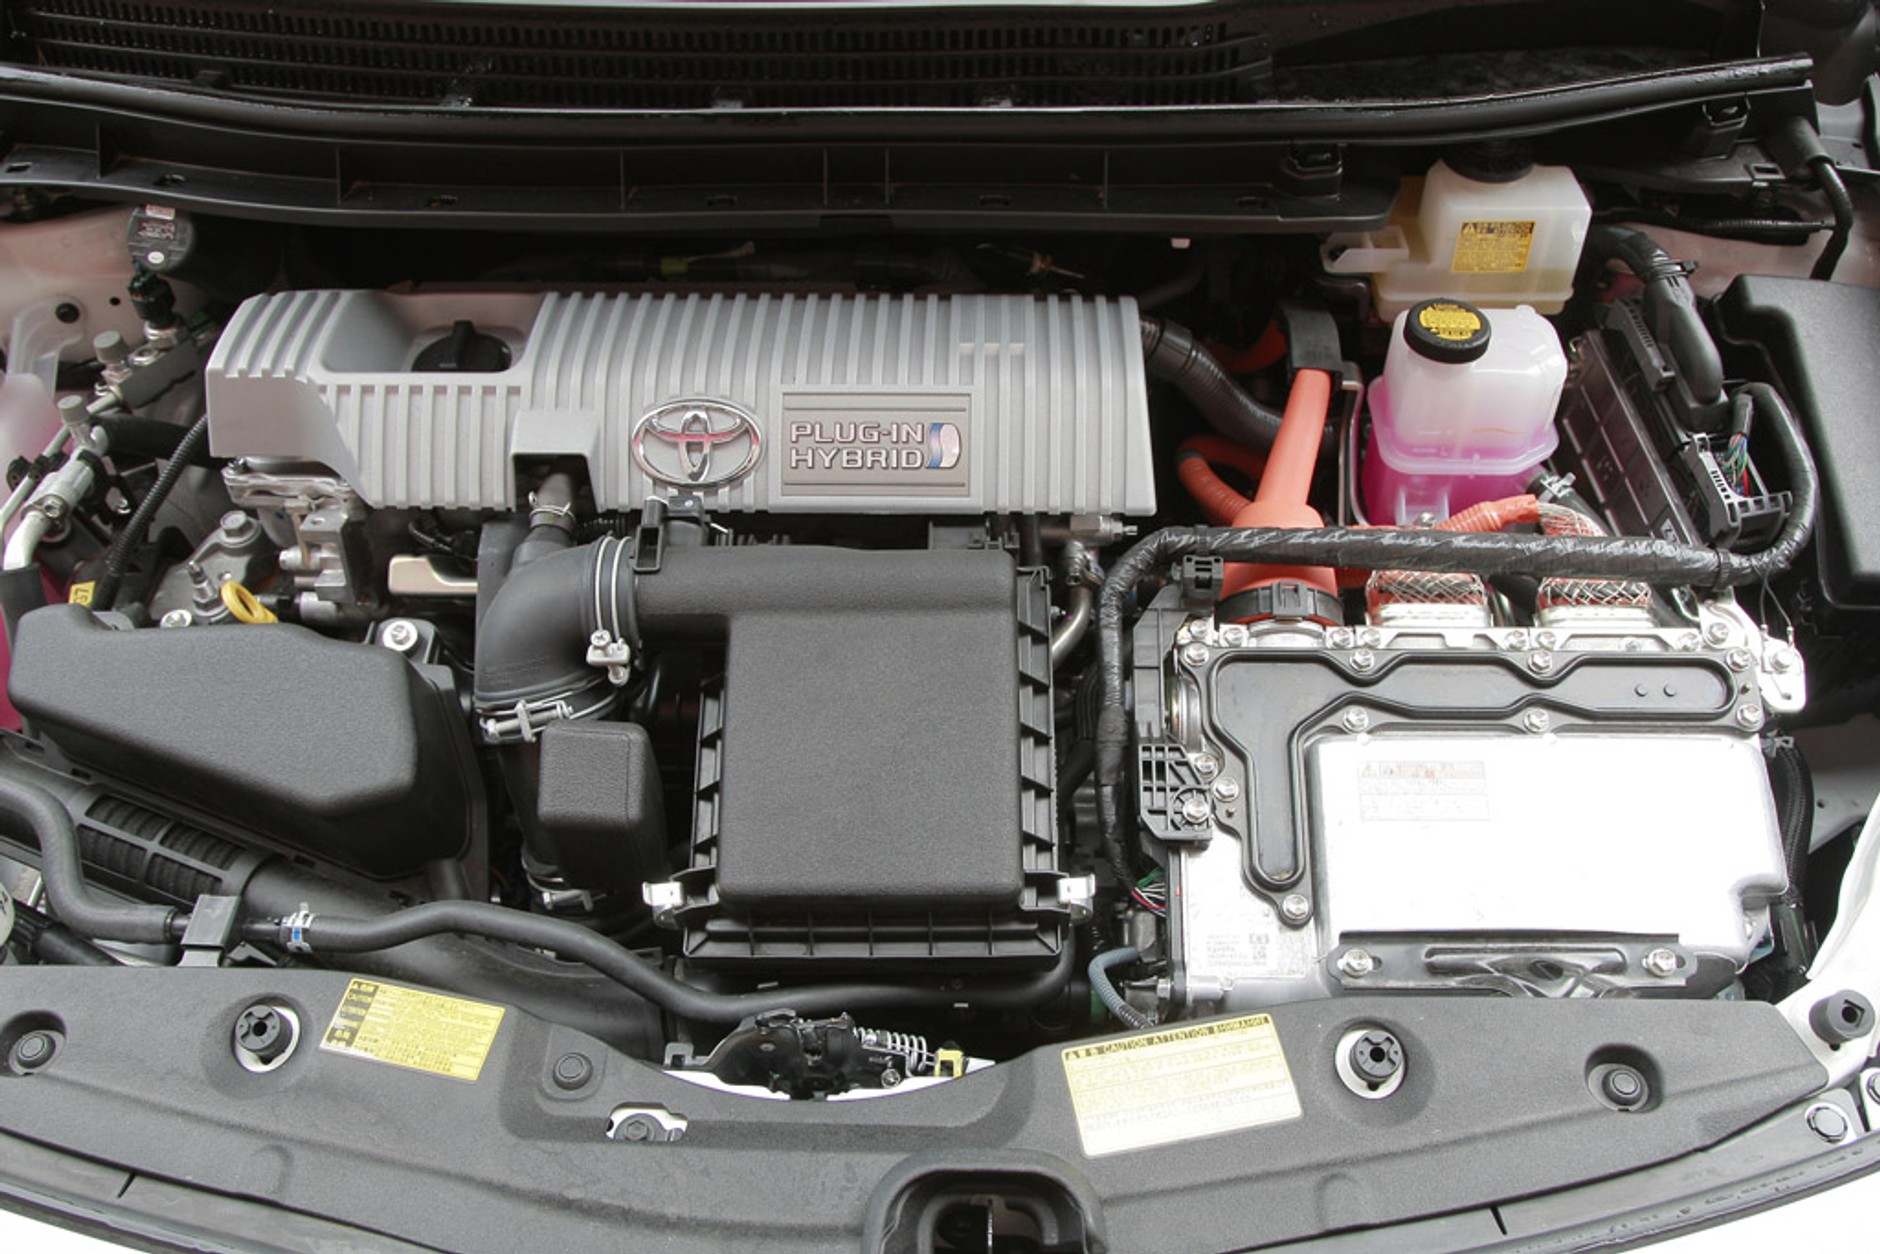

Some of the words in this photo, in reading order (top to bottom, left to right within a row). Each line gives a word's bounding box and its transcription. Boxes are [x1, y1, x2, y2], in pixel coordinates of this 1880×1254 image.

[790, 422, 924, 443] PLUG-IN
[790, 447, 924, 469] HYBRID
[1104, 1039, 1146, 1053] CAUTION
[1152, 1026, 1208, 1045] ATTENTION
